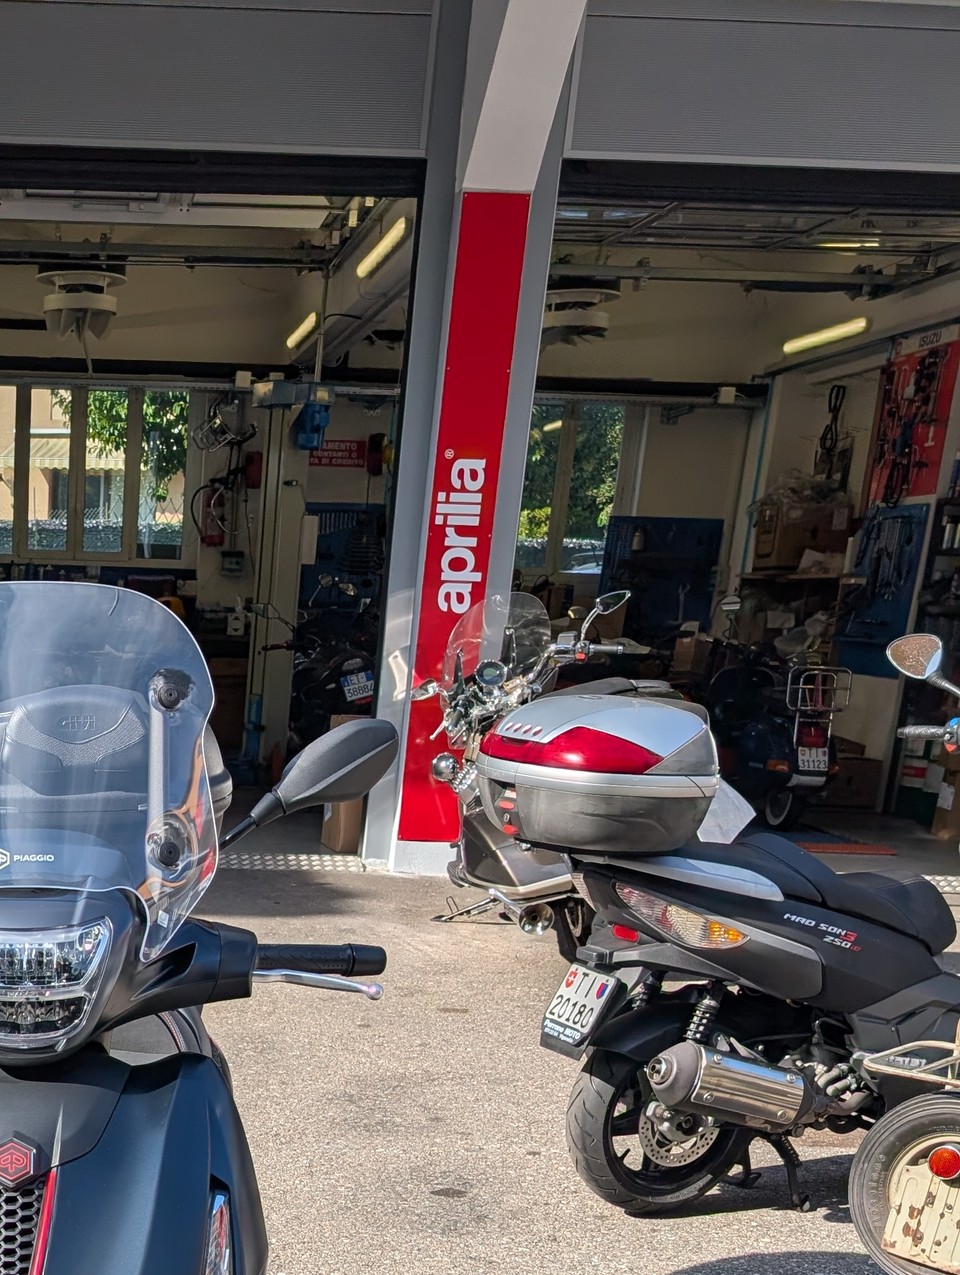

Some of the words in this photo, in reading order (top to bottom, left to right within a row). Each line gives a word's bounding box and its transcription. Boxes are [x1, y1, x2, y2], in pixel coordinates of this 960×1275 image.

[919, 330, 942, 348] ISUZU
[323, 441, 357, 450] AMENTO
[435, 458, 486, 614] aprilia
[800, 759, 827, 769] 31123
[13, 854, 55, 862] PIAGGIO
[574, 971, 598, 999] TI
[548, 994, 595, 1029] 20180
[564, 1026, 581, 1040] MOTO
